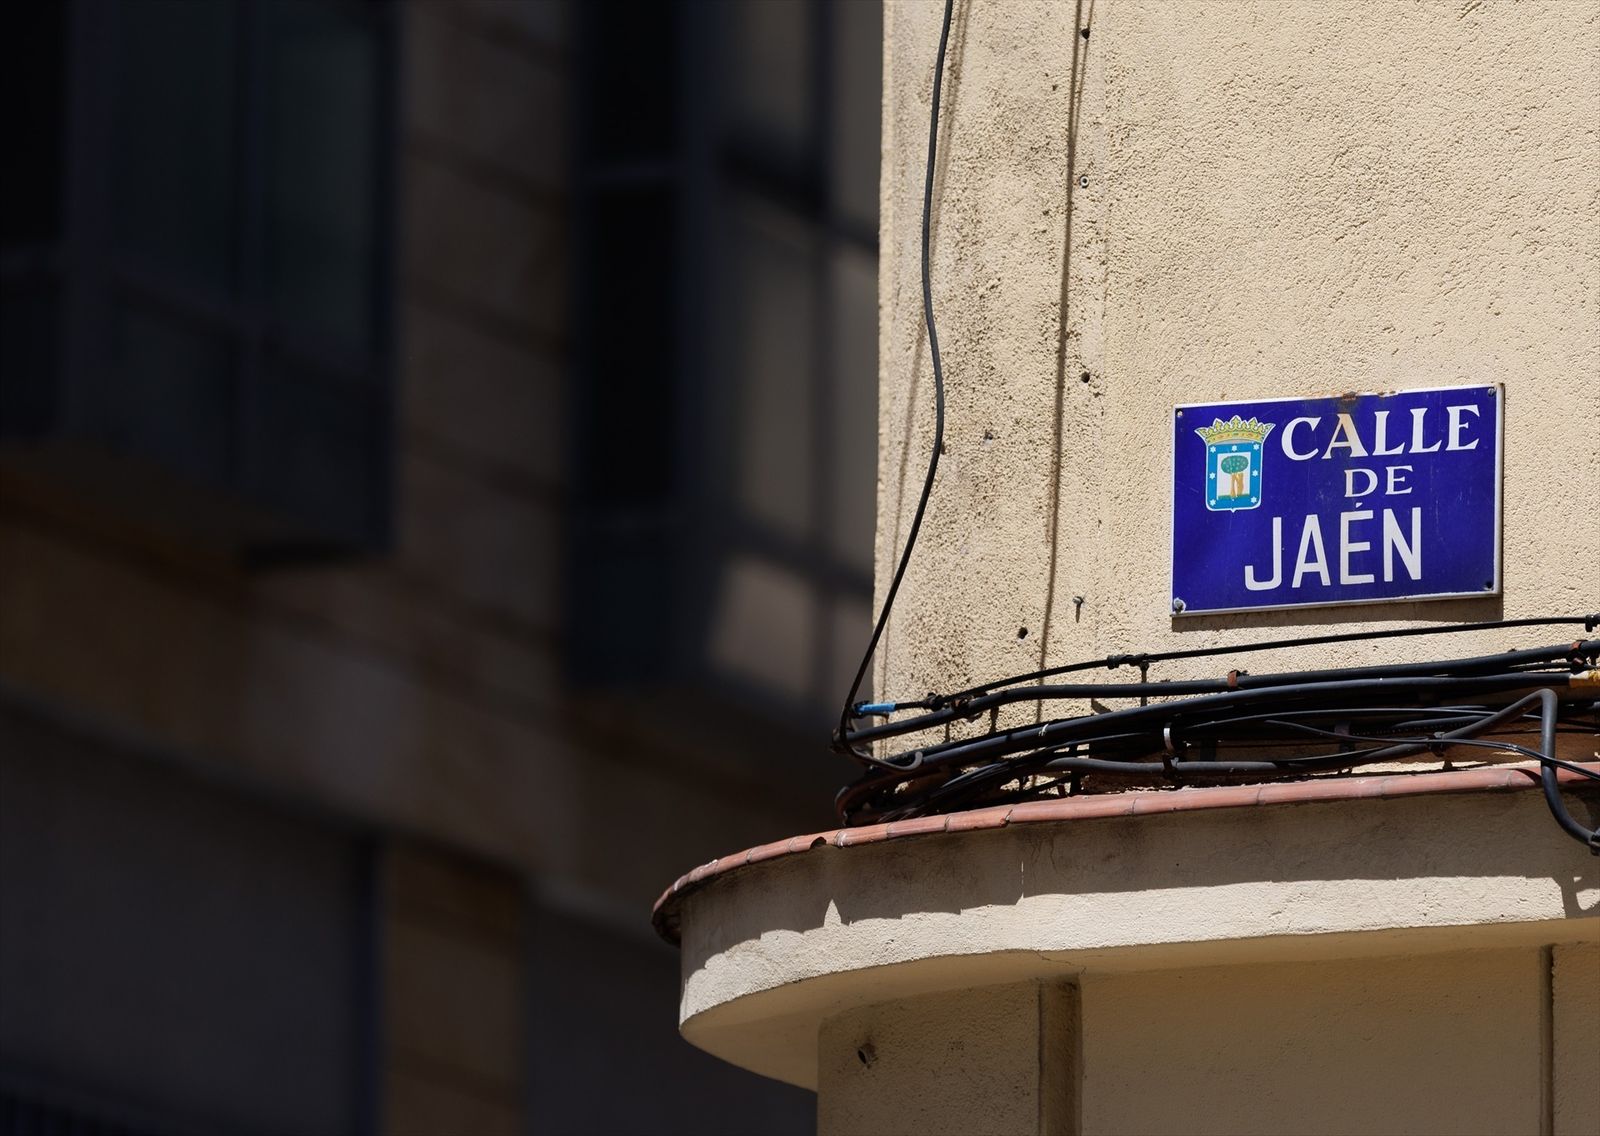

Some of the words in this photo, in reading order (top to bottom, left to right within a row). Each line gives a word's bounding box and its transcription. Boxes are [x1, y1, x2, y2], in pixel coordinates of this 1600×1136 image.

[1281, 404, 1480, 461] CALLE
[1344, 465, 1413, 498] DE
[1244, 502, 1422, 591] JAÉN
